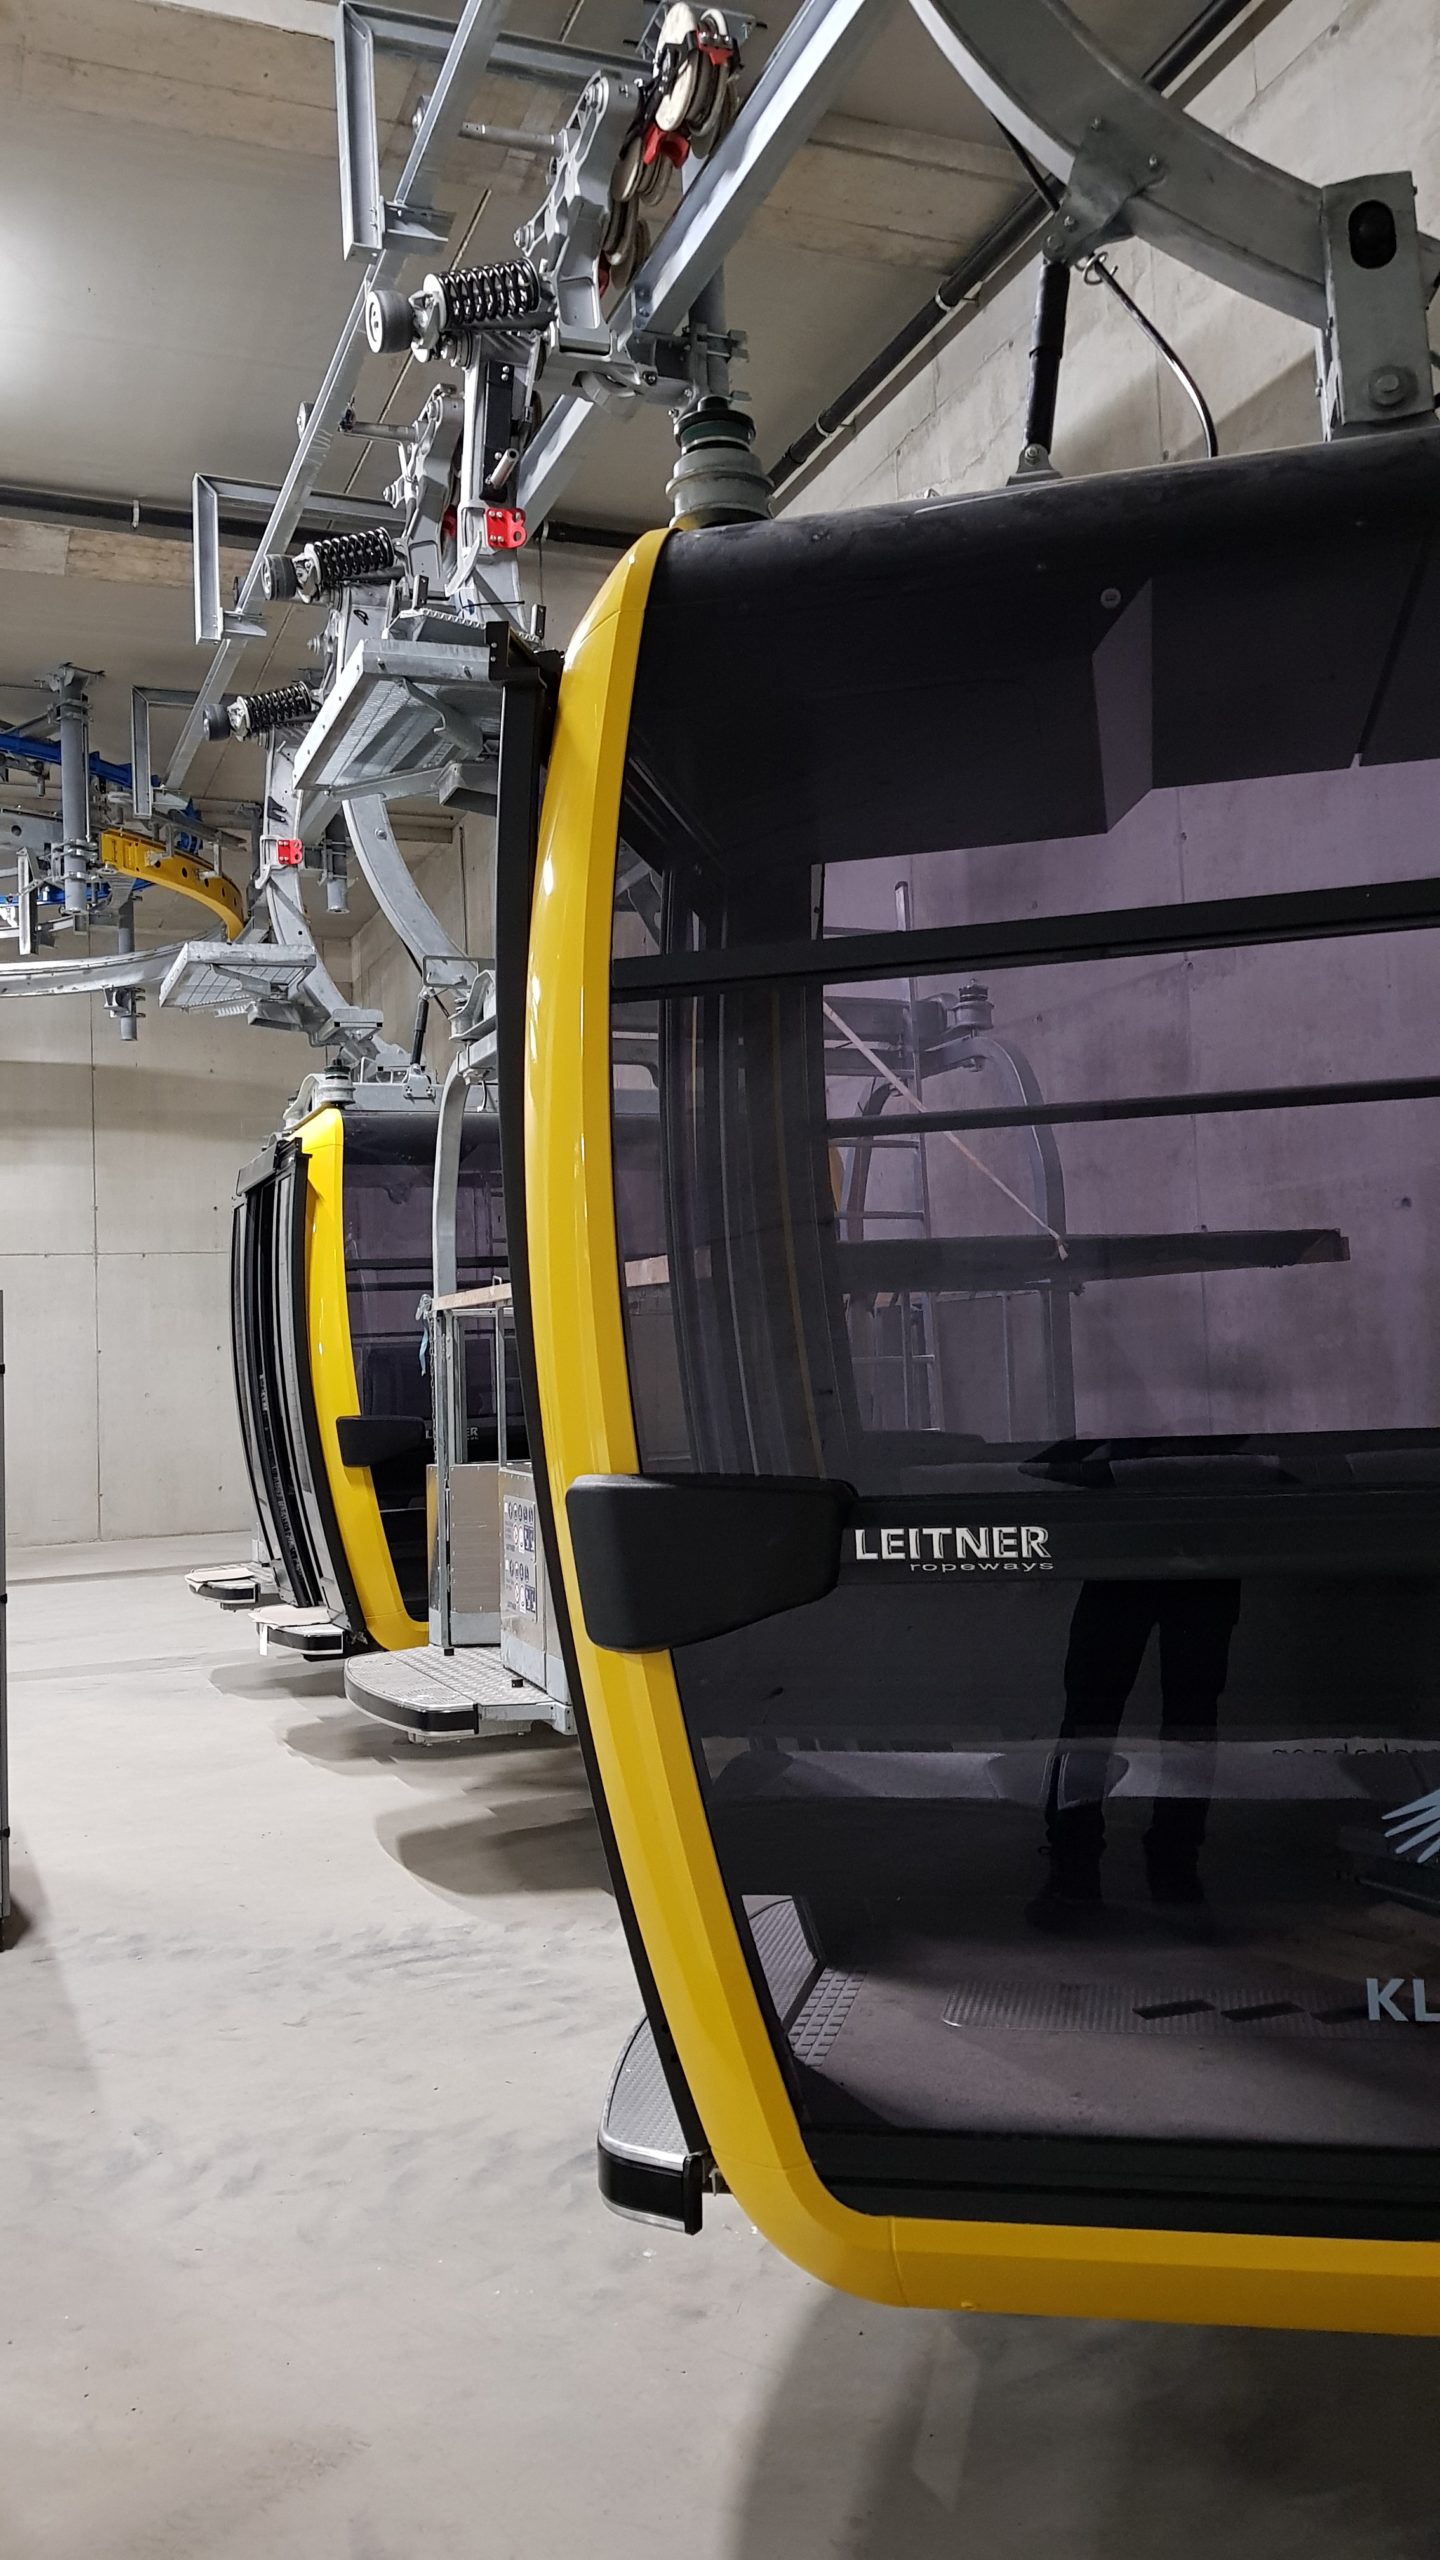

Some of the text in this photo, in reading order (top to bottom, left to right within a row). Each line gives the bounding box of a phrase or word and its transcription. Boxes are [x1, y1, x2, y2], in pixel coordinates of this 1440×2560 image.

[855, 1526, 1052, 1560] LEITNER
[910, 1560, 1054, 1572] ropeways
[1366, 1978, 1440, 2022] KL
